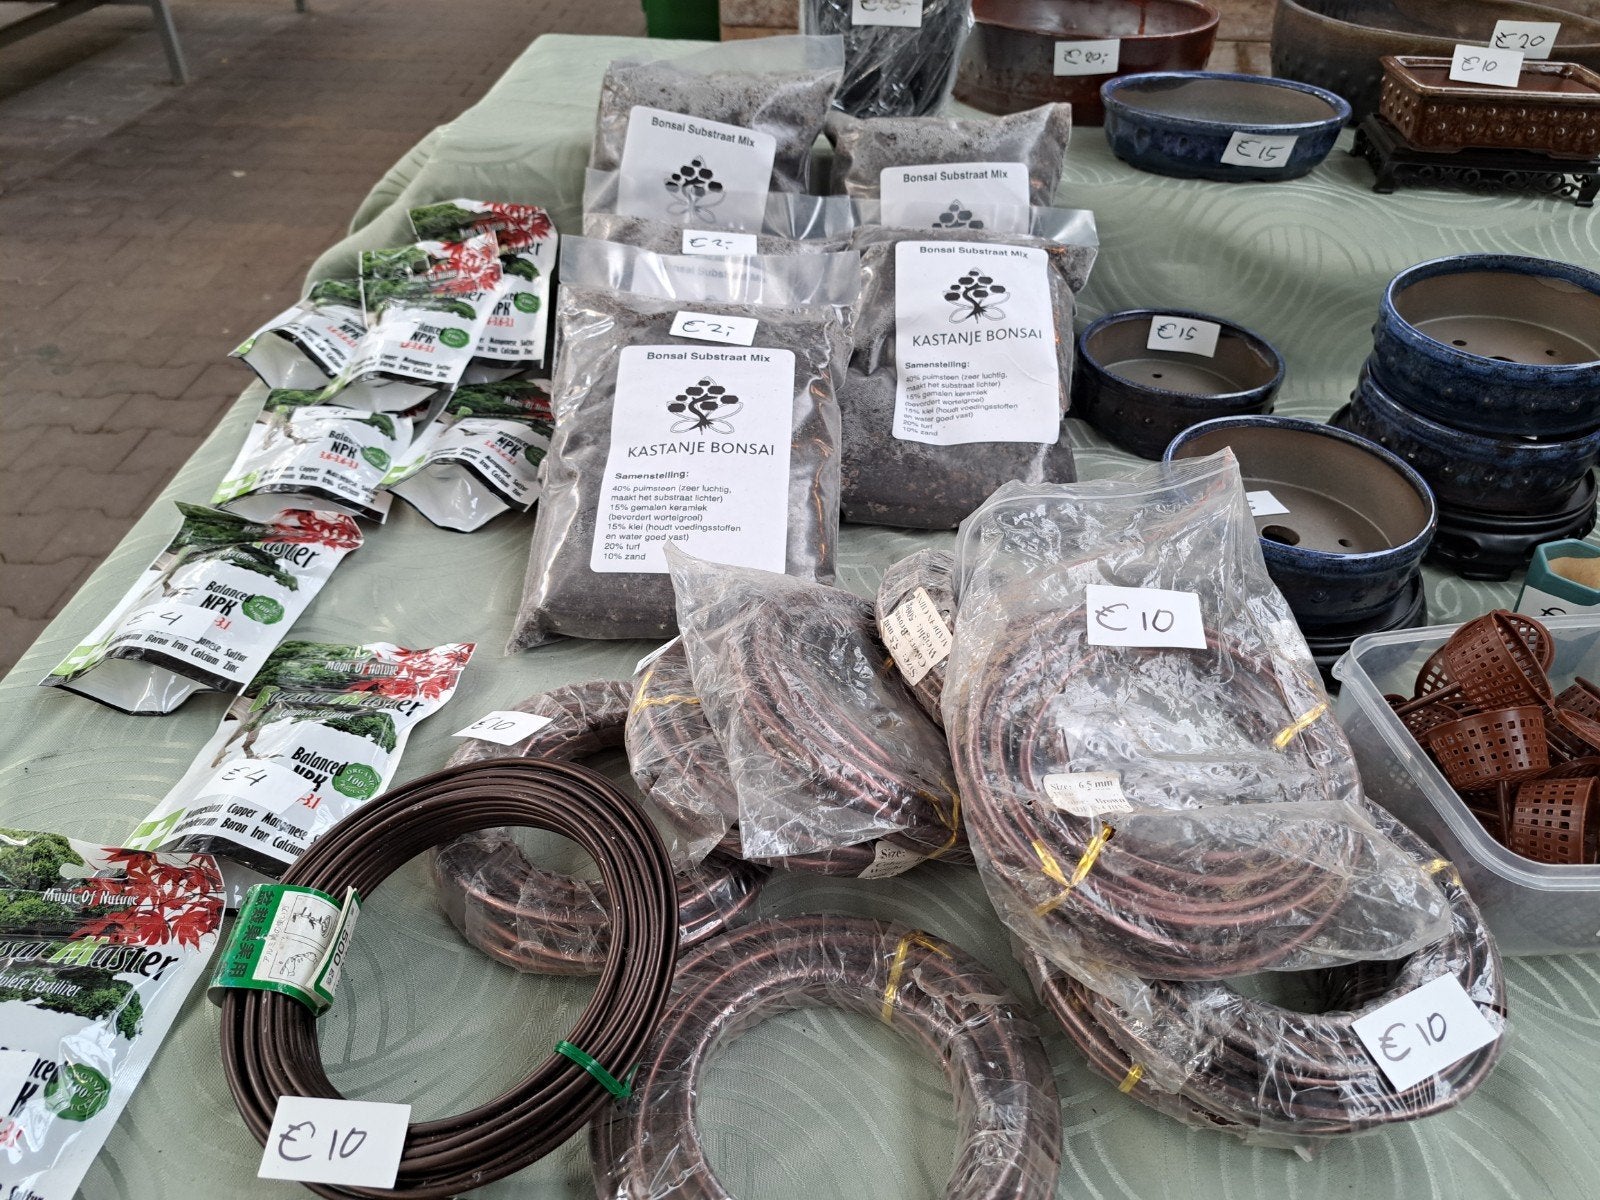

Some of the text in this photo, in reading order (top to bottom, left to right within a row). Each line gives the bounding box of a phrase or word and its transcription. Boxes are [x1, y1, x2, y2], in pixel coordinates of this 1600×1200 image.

[651, 116, 756, 148] Bonsai Substraat Mix
[903, 169, 1008, 183] Bonsai Substraat Mix
[919, 246, 1029, 259] Bonsai Substraat Mix
[409, 331, 437, 345] NPK
[912, 327, 1043, 347] KASTANJE BONSAI
[646, 352, 771, 363] Bonsai Substraat Mix
[905, 361, 970, 370] Samenstelling:
[330, 440, 358, 459] NPK
[494, 436, 522, 457] NPK
[627, 441, 775, 458] KASTANJE BONSAI
[614, 471, 690, 480] Samenstelling:
[632, 485, 676, 493] puimsteen
[678, 485, 700, 493] (zeer
[702, 484, 733, 494] luchtig,
[653, 494, 694, 502] substraat
[694, 494, 724, 503] lichter)
[630, 503, 667, 512] gemalen
[669, 503, 708, 512] keramiek
[608, 513, 652, 522] (bevordert
[628, 522, 644, 531] klei
[645, 523, 673, 532] (houdt
[674, 523, 742, 532] voedingsstoffen
[644, 533, 667, 542] goed
[667, 533, 690, 542] vast)
[604, 542, 641, 550] 20% turf
[624, 552, 647, 561] zand
[204, 580, 256, 602] Balanced
[200, 594, 239, 617] NPK
[145, 633, 169, 646] Boron
[171, 639, 190, 652] Iron
[190, 647, 220, 666] Calcium
[222, 660, 240, 674] Zinc
[223, 647, 249, 663] Sulfur
[325, 660, 399, 677] Magic Of Nature
[291, 746, 349, 777] Balanced
[226, 802, 258, 819] Copper
[220, 817, 248, 834] Boron
[250, 825, 271, 843] Iron
[881, 848, 906, 860] Size:
[42, 887, 140, 906] Magic Of Nature
[334, 929, 349, 967] 500
[47, 935, 179, 982] Master
[29, 976, 83, 998] Fertilizer
